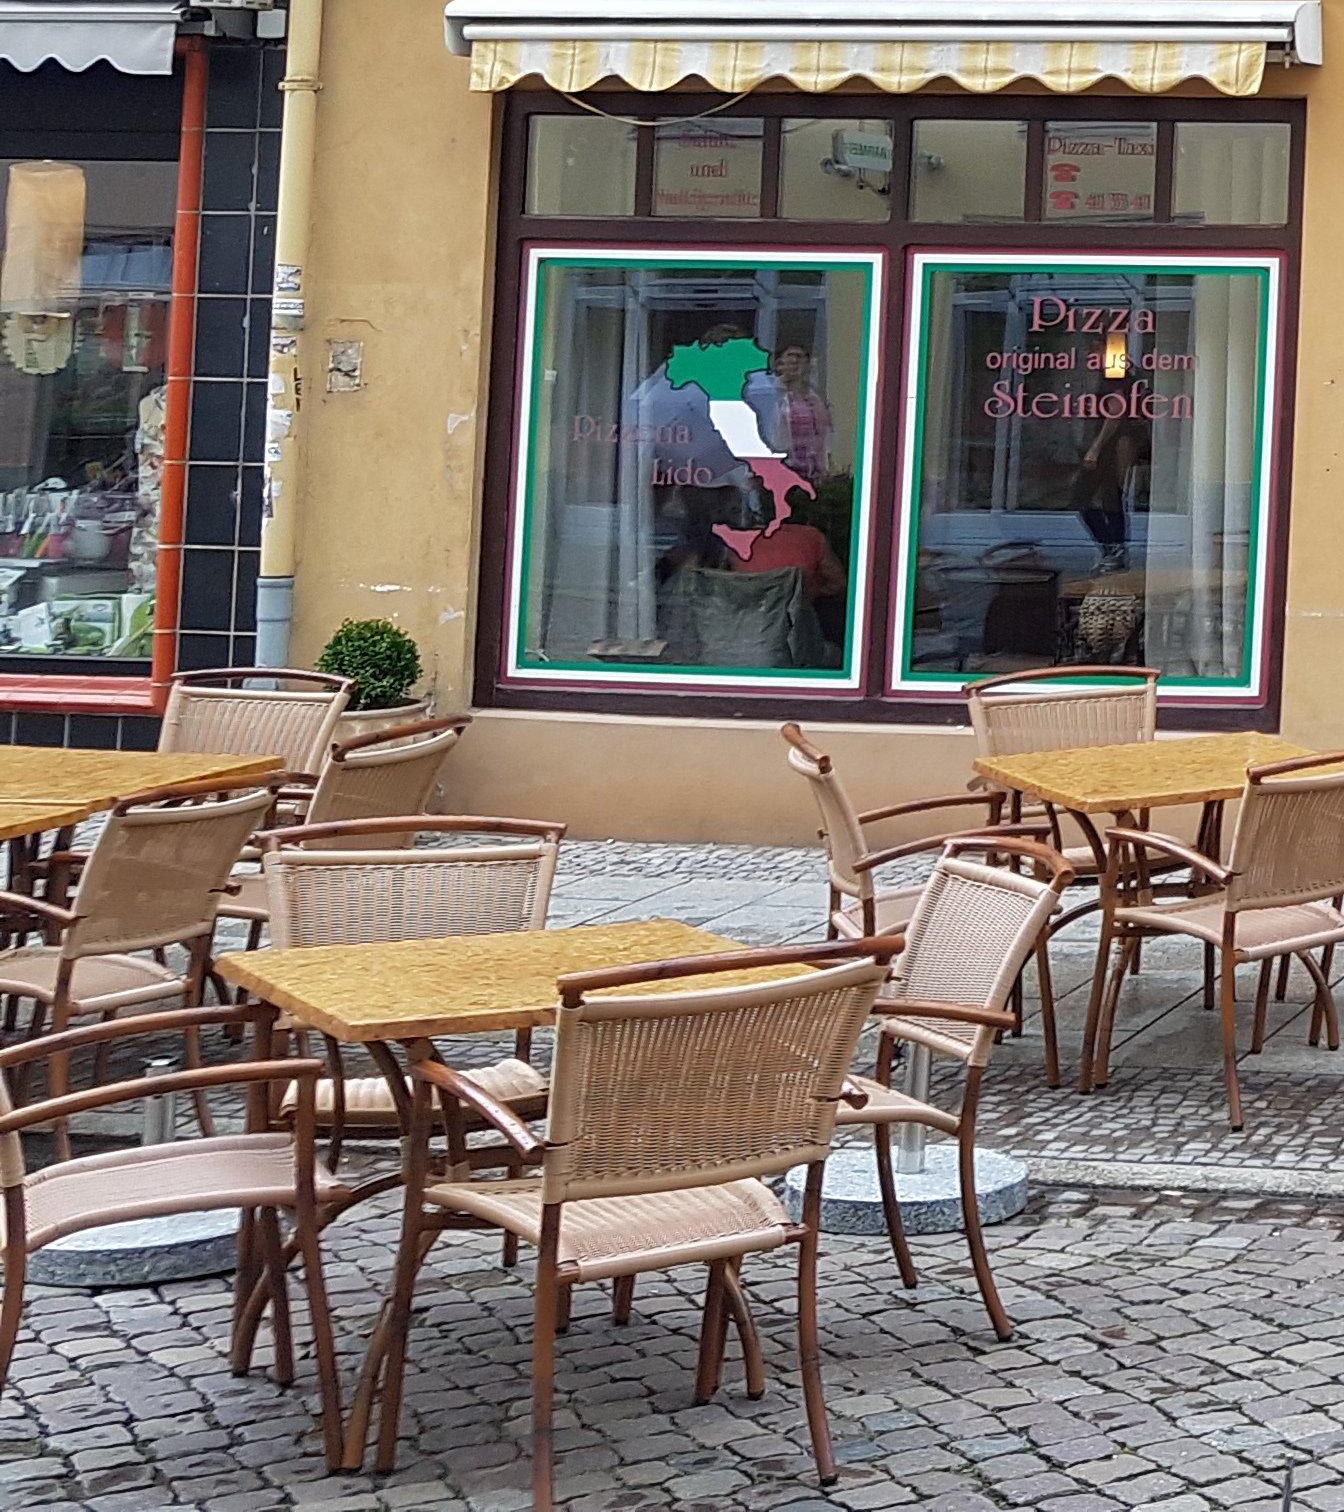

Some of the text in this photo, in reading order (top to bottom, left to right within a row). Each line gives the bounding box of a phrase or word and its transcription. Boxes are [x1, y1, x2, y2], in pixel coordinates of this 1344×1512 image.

[1028, 295, 1157, 335] Pizza
[985, 346, 1196, 376] original aus dem
[983, 378, 1195, 419] Steinofen
[651, 457, 713, 487] Lido
